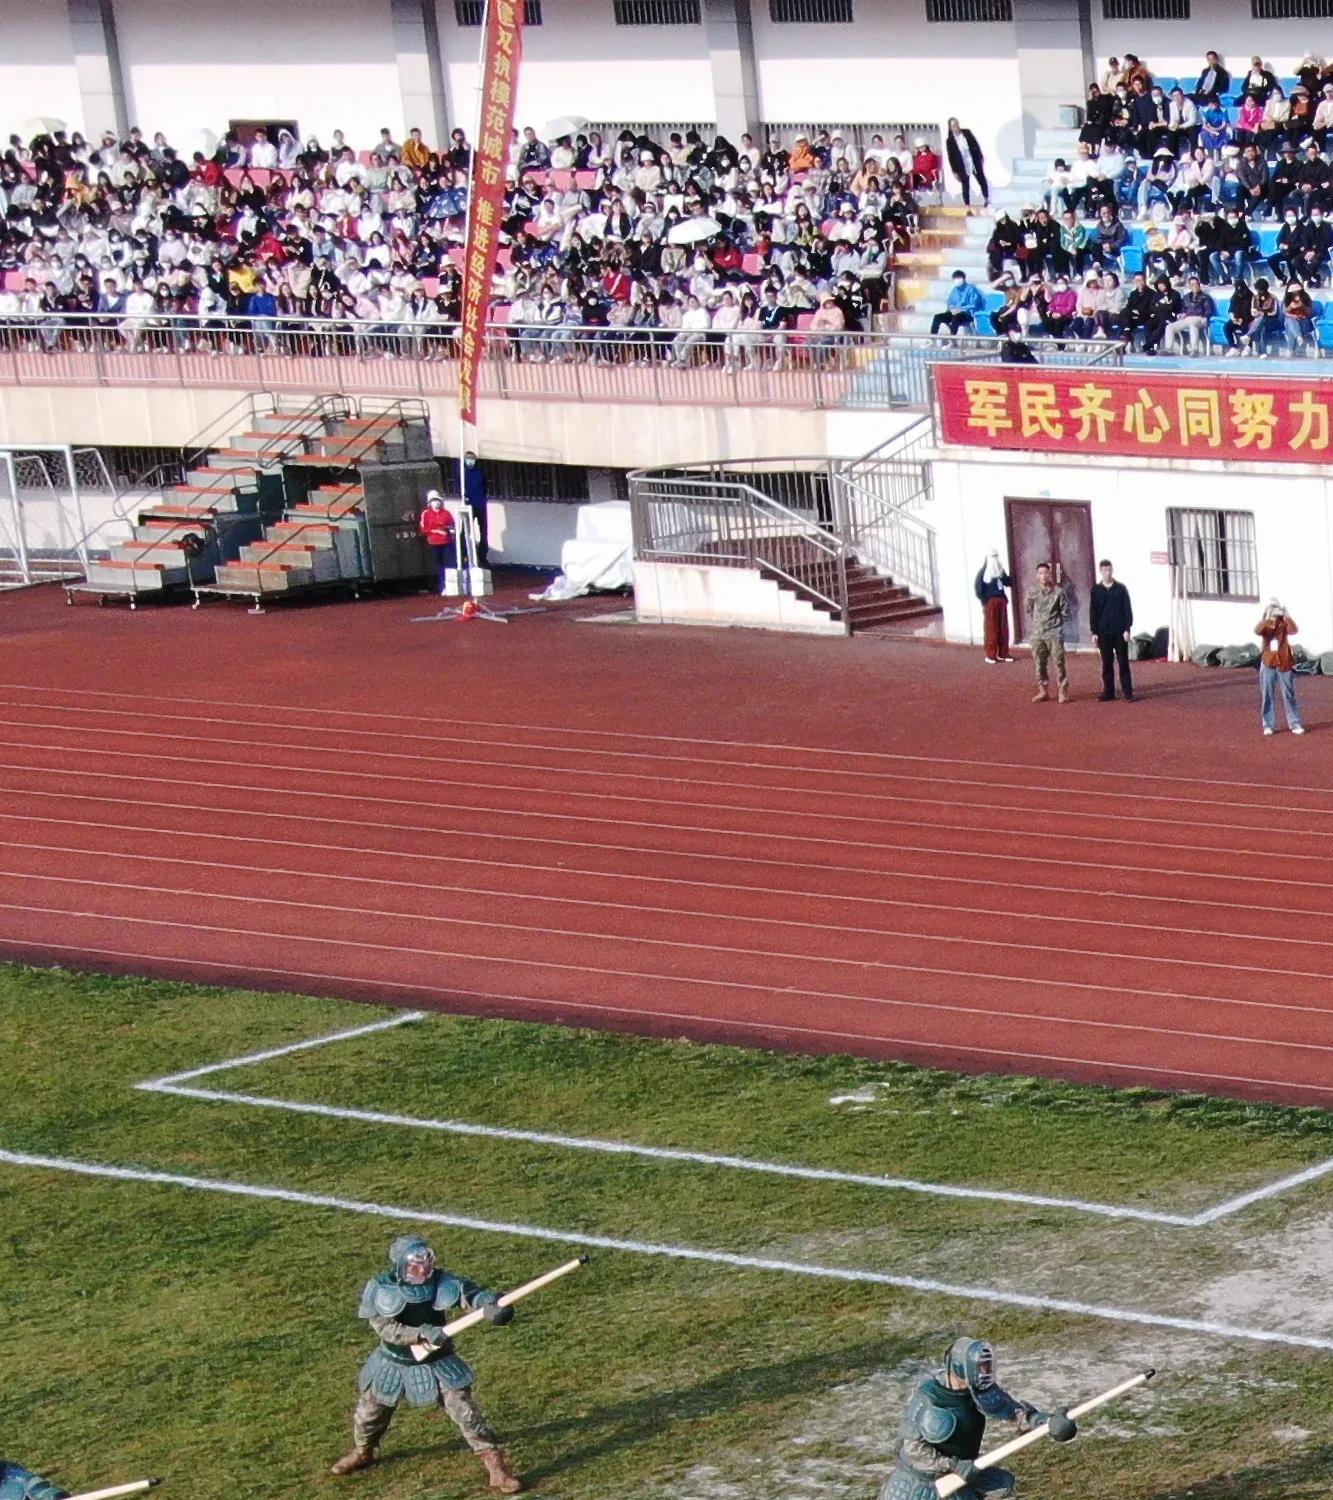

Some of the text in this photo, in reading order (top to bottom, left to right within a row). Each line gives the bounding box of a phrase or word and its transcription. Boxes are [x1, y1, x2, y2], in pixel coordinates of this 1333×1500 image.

[481, 0, 516, 185] 建双拥模范城市
[964, 379, 1332, 450] 军民齐心同努力
